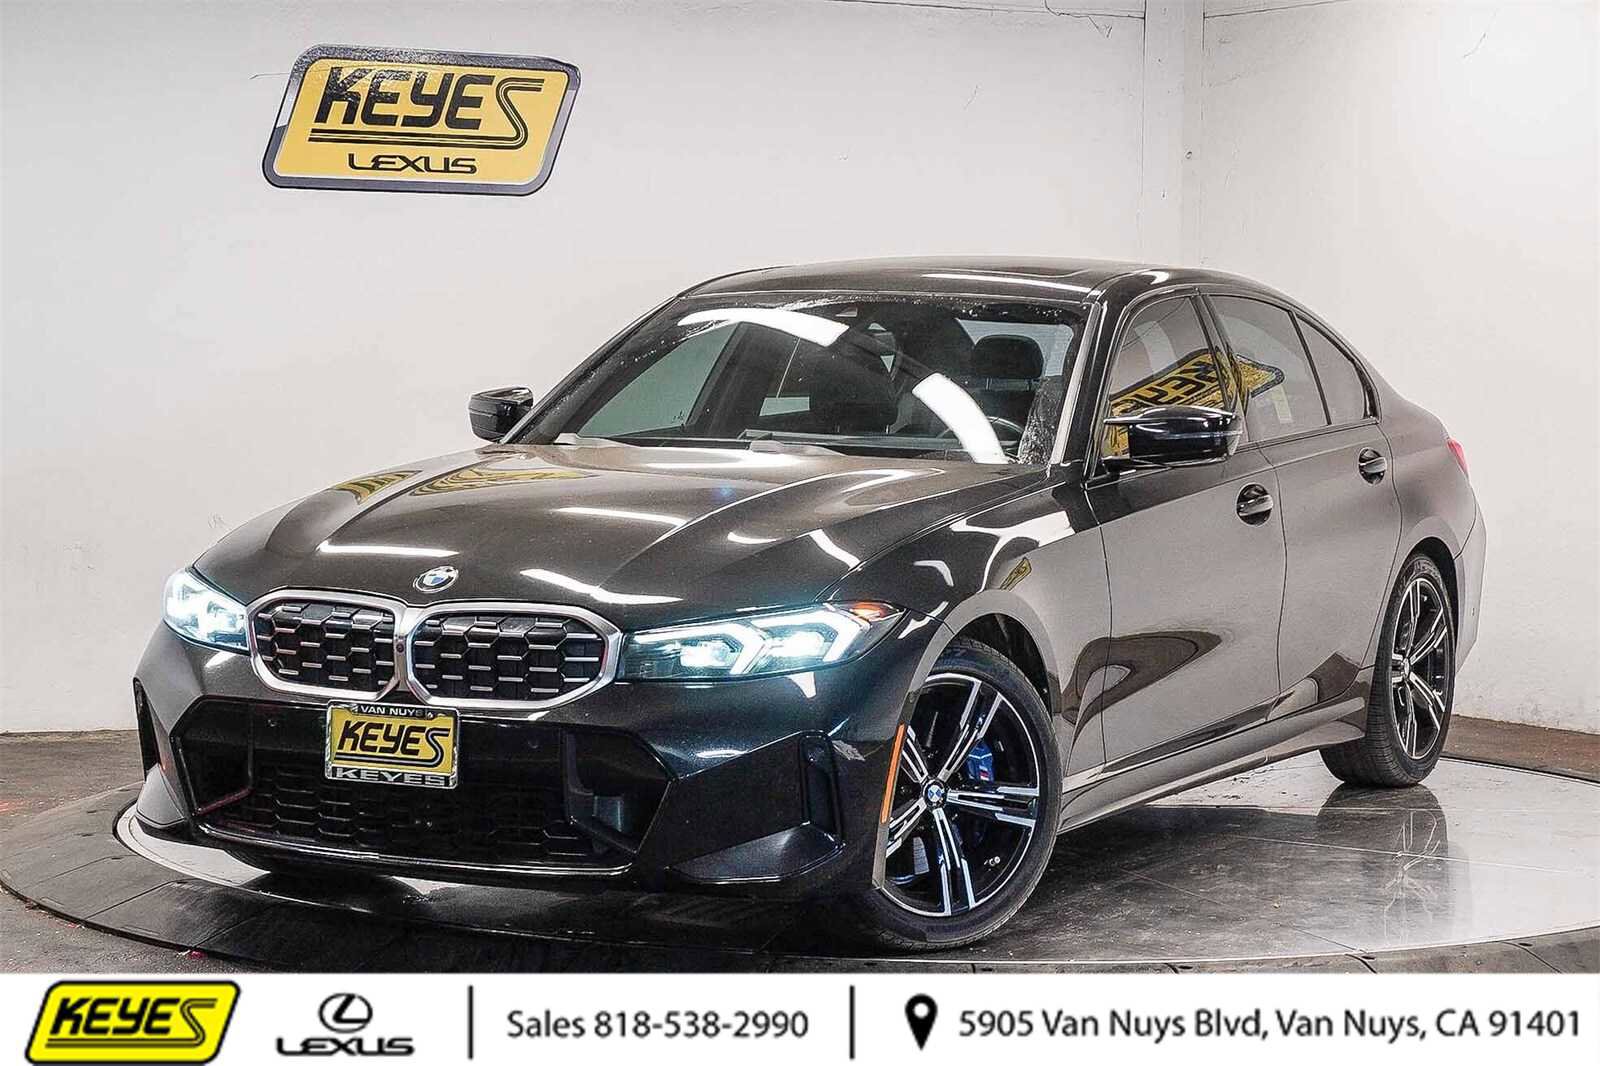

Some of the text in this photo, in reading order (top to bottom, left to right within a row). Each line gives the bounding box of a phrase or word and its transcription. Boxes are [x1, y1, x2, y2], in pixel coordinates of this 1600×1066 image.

[308, 66, 545, 150] KEYES
[348, 153, 478, 174] LEXUS
[361, 705, 423, 717] VAN NUYS
[335, 720, 451, 768] KEYES
[336, 767, 445, 786] KEYES
